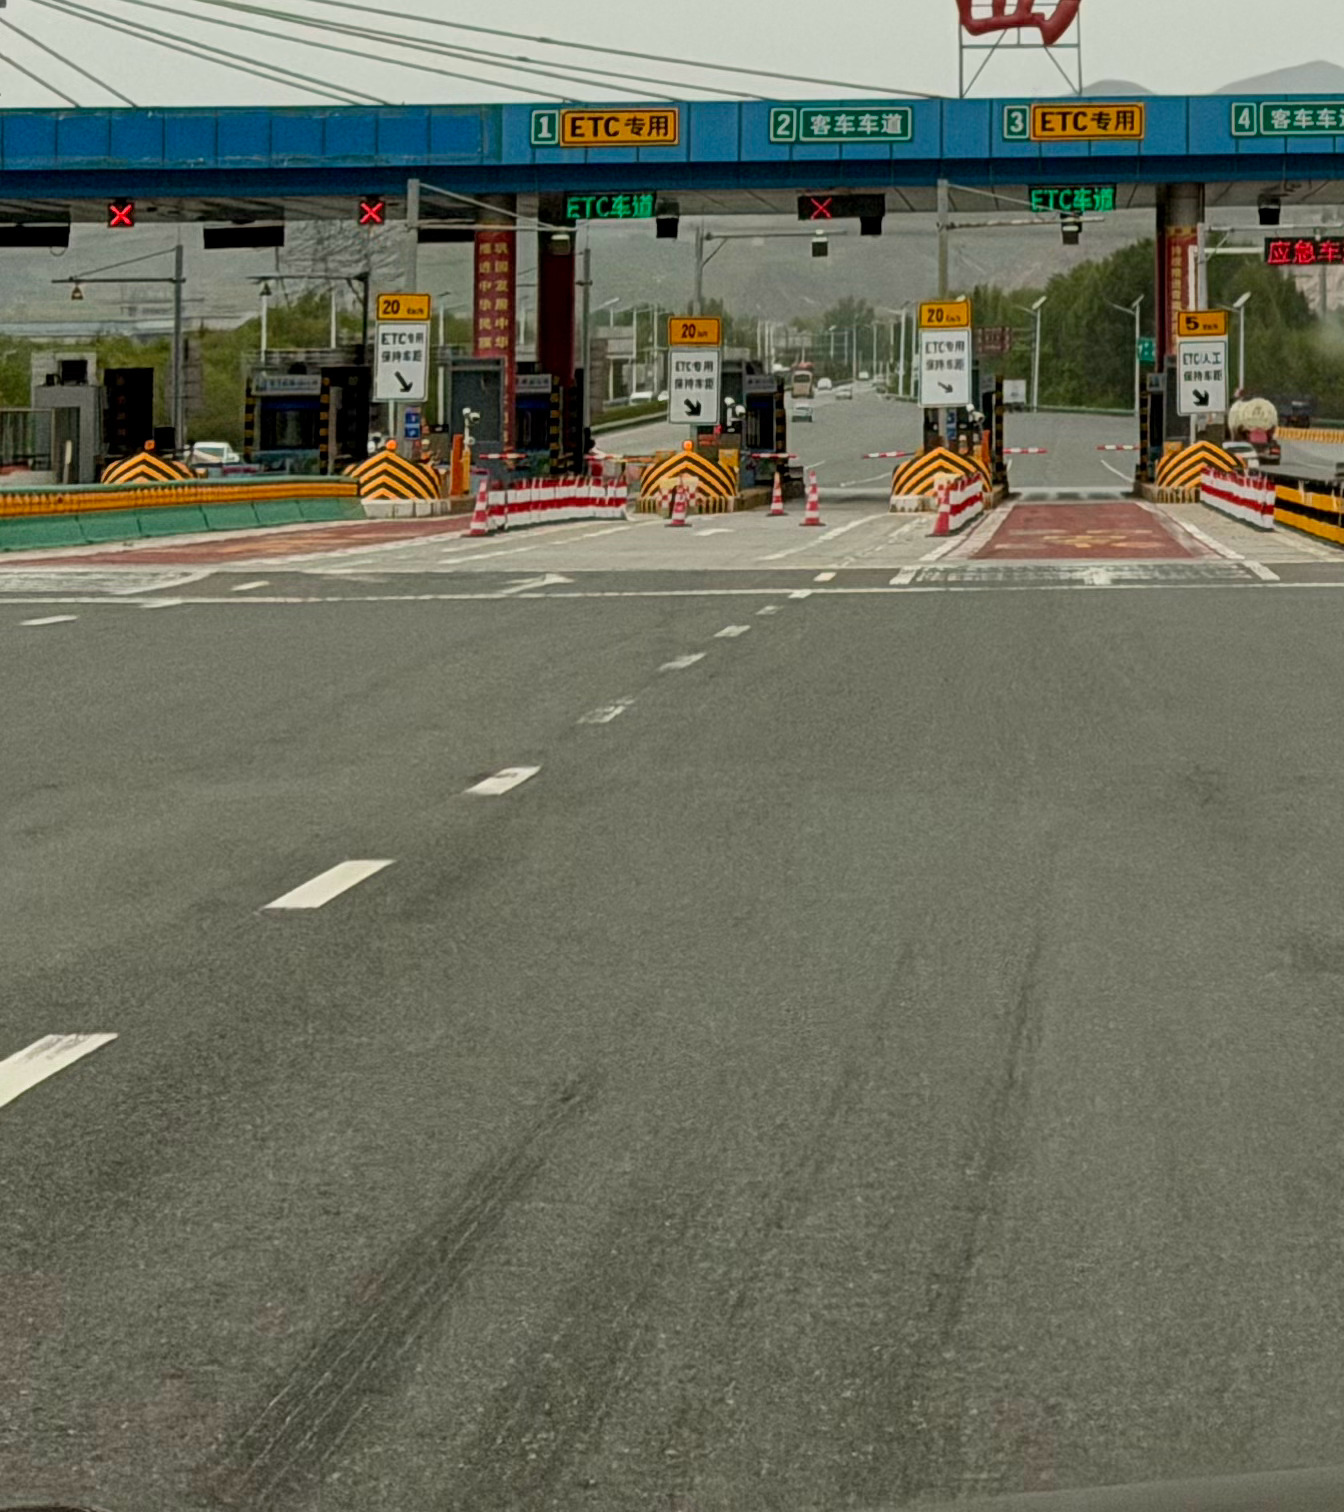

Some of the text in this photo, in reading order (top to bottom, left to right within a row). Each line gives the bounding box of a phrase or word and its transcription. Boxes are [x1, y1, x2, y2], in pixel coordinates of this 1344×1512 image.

[537, 114, 670, 139] 1 ETC专用
[776, 113, 903, 137] 2 客车车道
[1009, 110, 1136, 133] 3 ETC专用
[1237, 107, 1251, 130] 4
[567, 194, 655, 219] ETC车道
[1030, 187, 1117, 213] ETC车道
[381, 299, 401, 315] 20
[926, 307, 945, 324] 20
[680, 323, 697, 339] 20
[1184, 315, 1200, 331] 5
